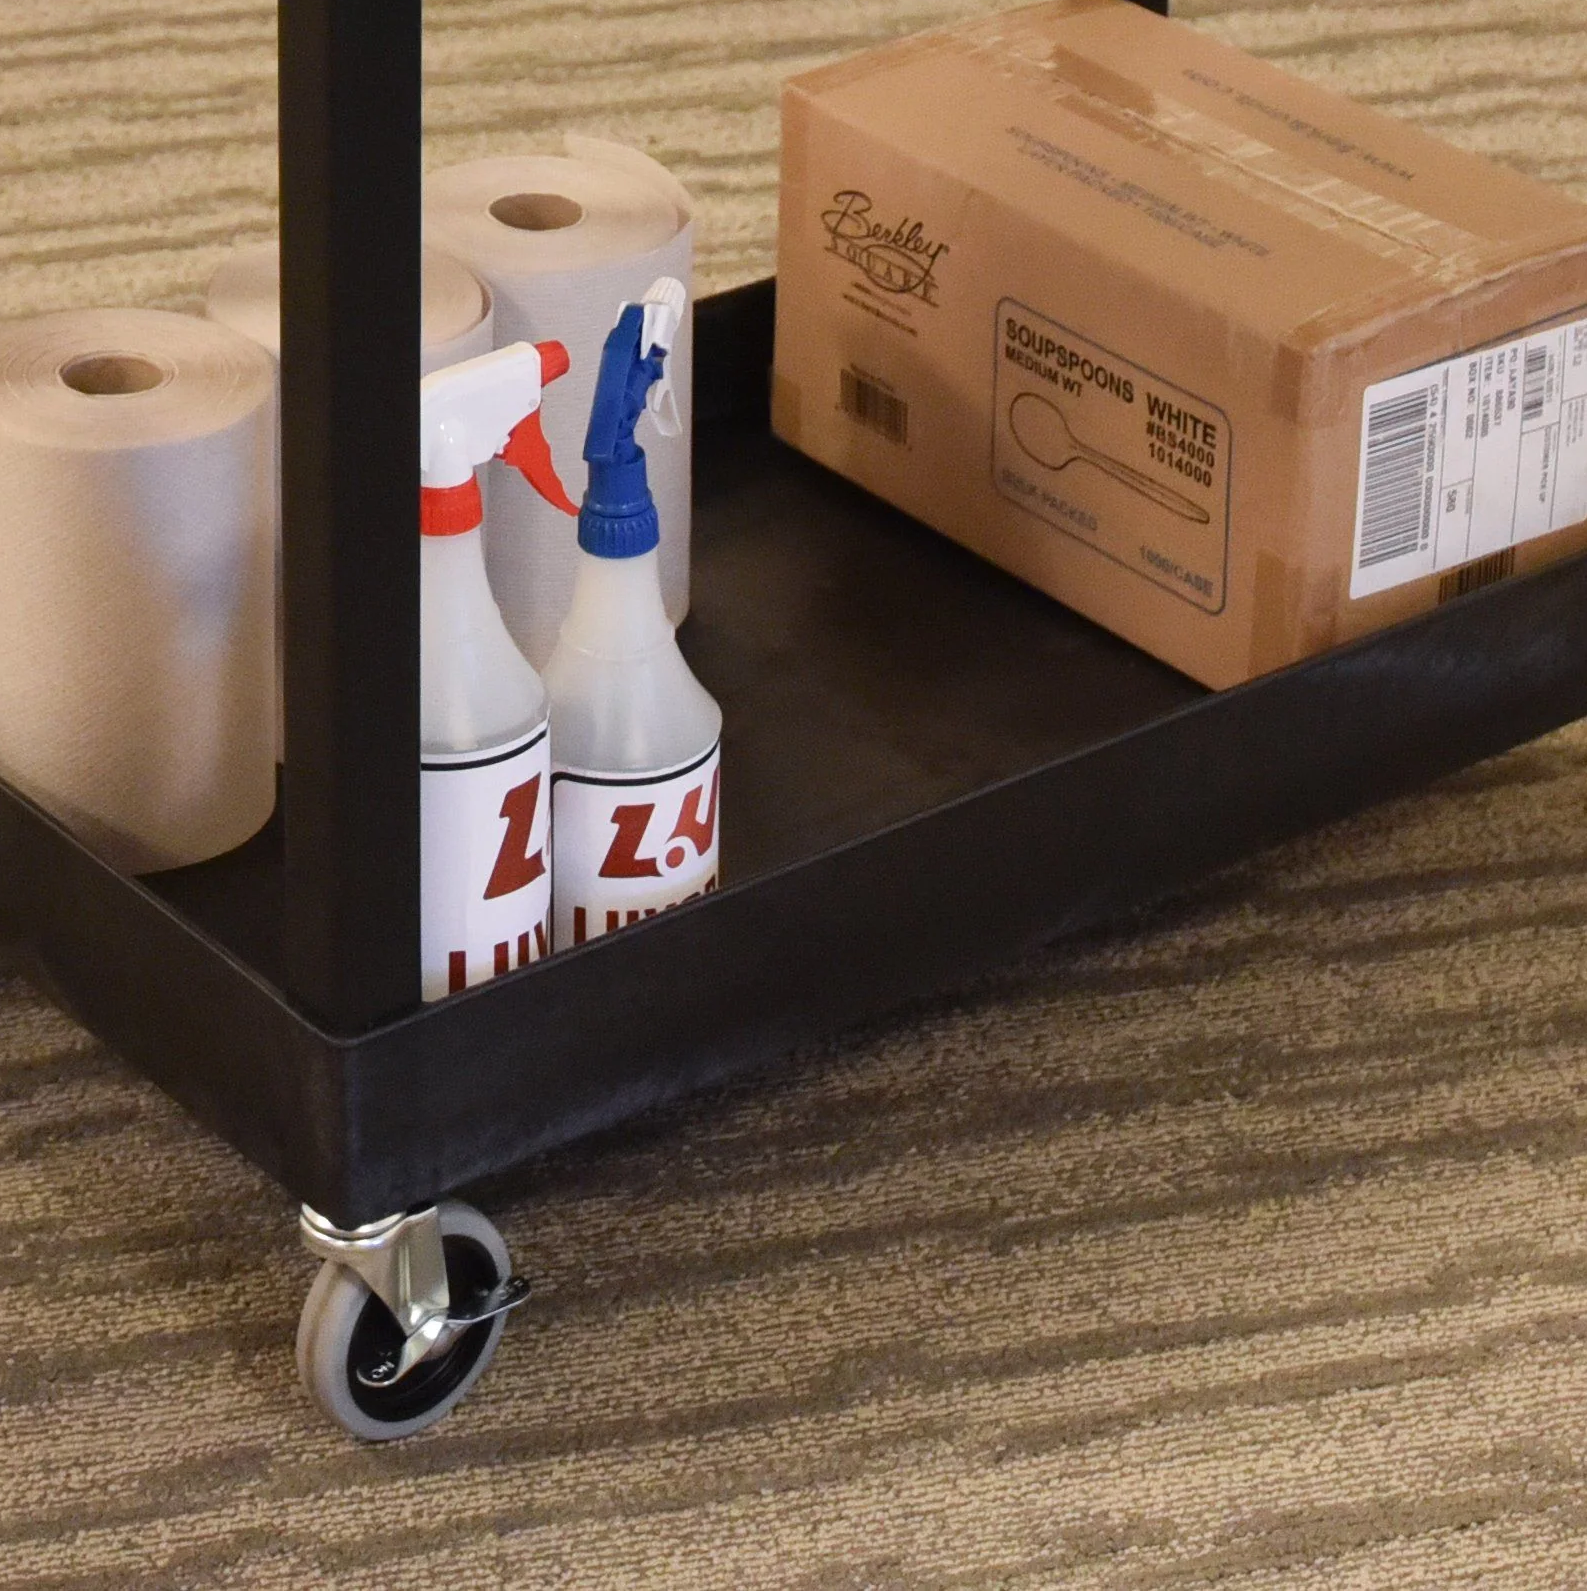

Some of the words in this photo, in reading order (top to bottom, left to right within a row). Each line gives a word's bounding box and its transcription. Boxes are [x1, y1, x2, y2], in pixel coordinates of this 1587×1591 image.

[821, 190, 949, 263] Berkley
[1005, 344, 1059, 385] MEDIUM
[1063, 377, 1083, 397] WT
[1006, 318, 1134, 404] SOUPSPOONS
[1146, 391, 1217, 449] WHITE
[1146, 421, 1215, 468] #BS4000
[1148, 443, 1212, 488] 1014000
